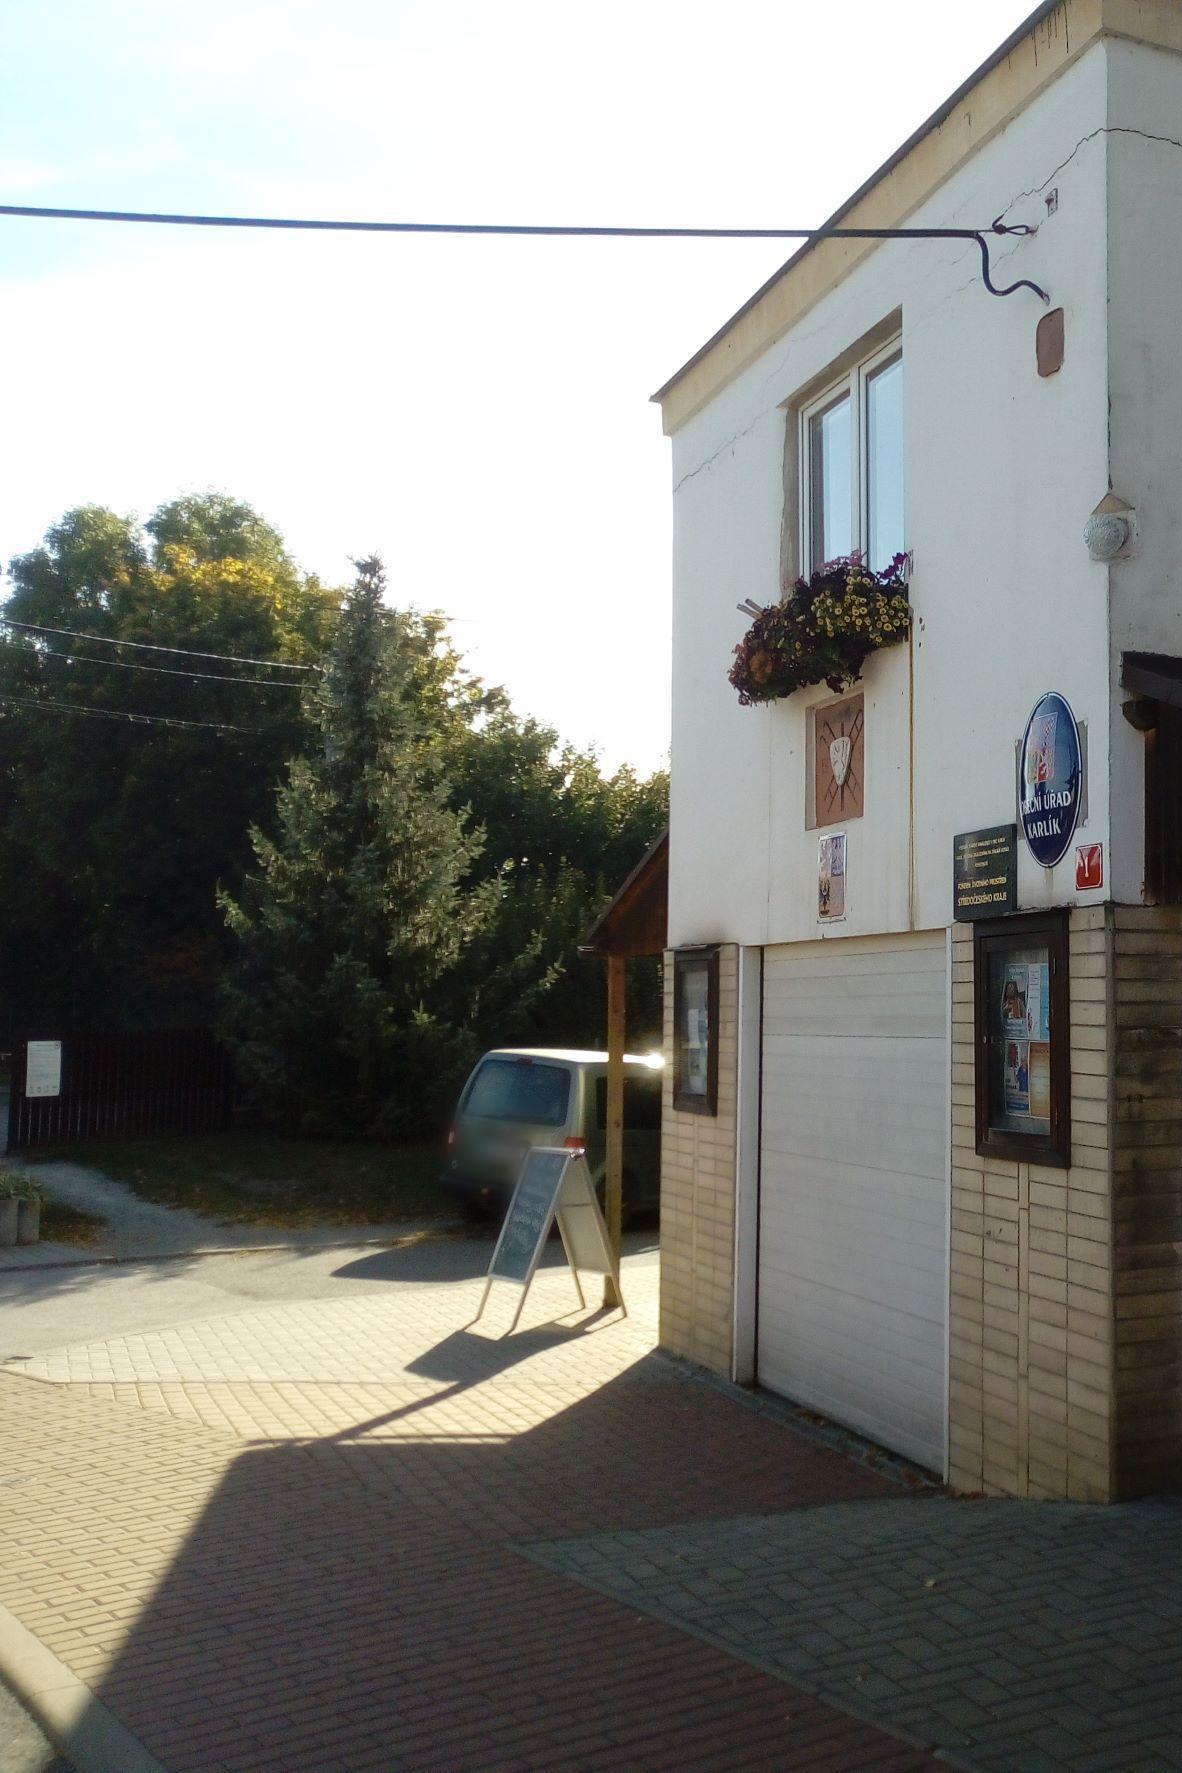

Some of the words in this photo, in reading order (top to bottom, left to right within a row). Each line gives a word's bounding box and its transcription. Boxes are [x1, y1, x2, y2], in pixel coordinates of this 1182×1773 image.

[1022, 792, 1042, 815] OBECNÍ
[1044, 789, 1072, 810] ÚŘAD
[1027, 814, 1062, 839] KARLÍK
[993, 891, 1007, 902] KRAJE
